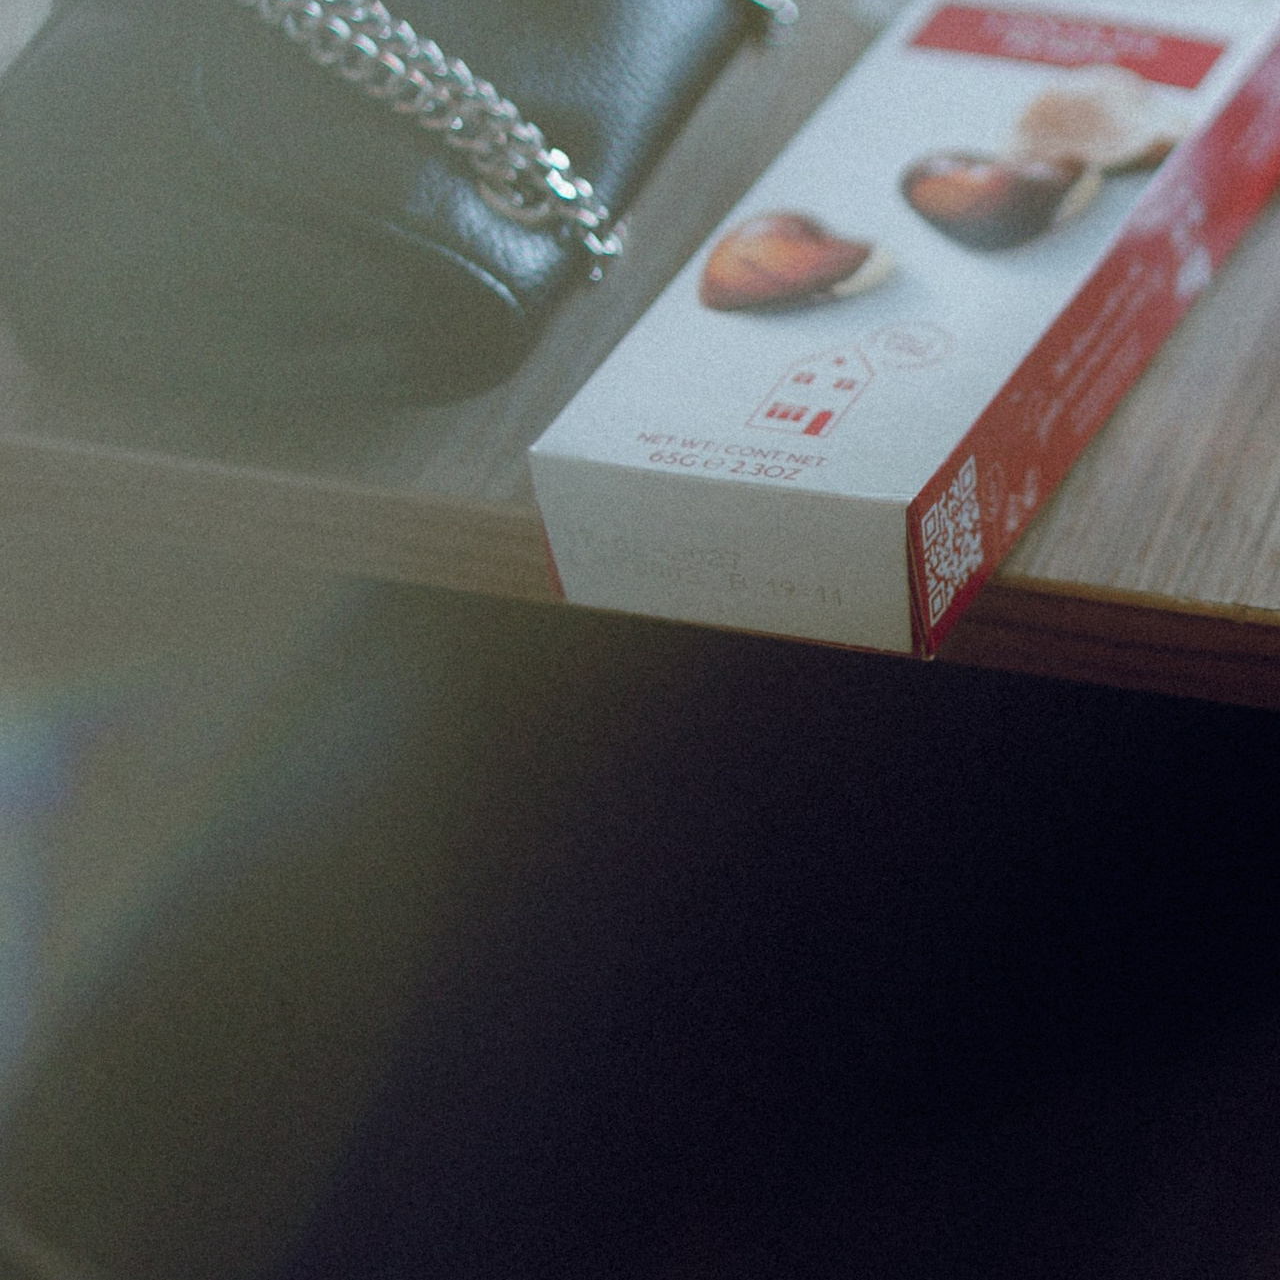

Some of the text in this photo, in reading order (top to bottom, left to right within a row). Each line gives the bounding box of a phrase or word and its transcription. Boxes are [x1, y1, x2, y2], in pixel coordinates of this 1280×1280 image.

[637, 431, 676, 445] NET
[786, 452, 828, 468] NET
[649, 450, 699, 468] 65G
